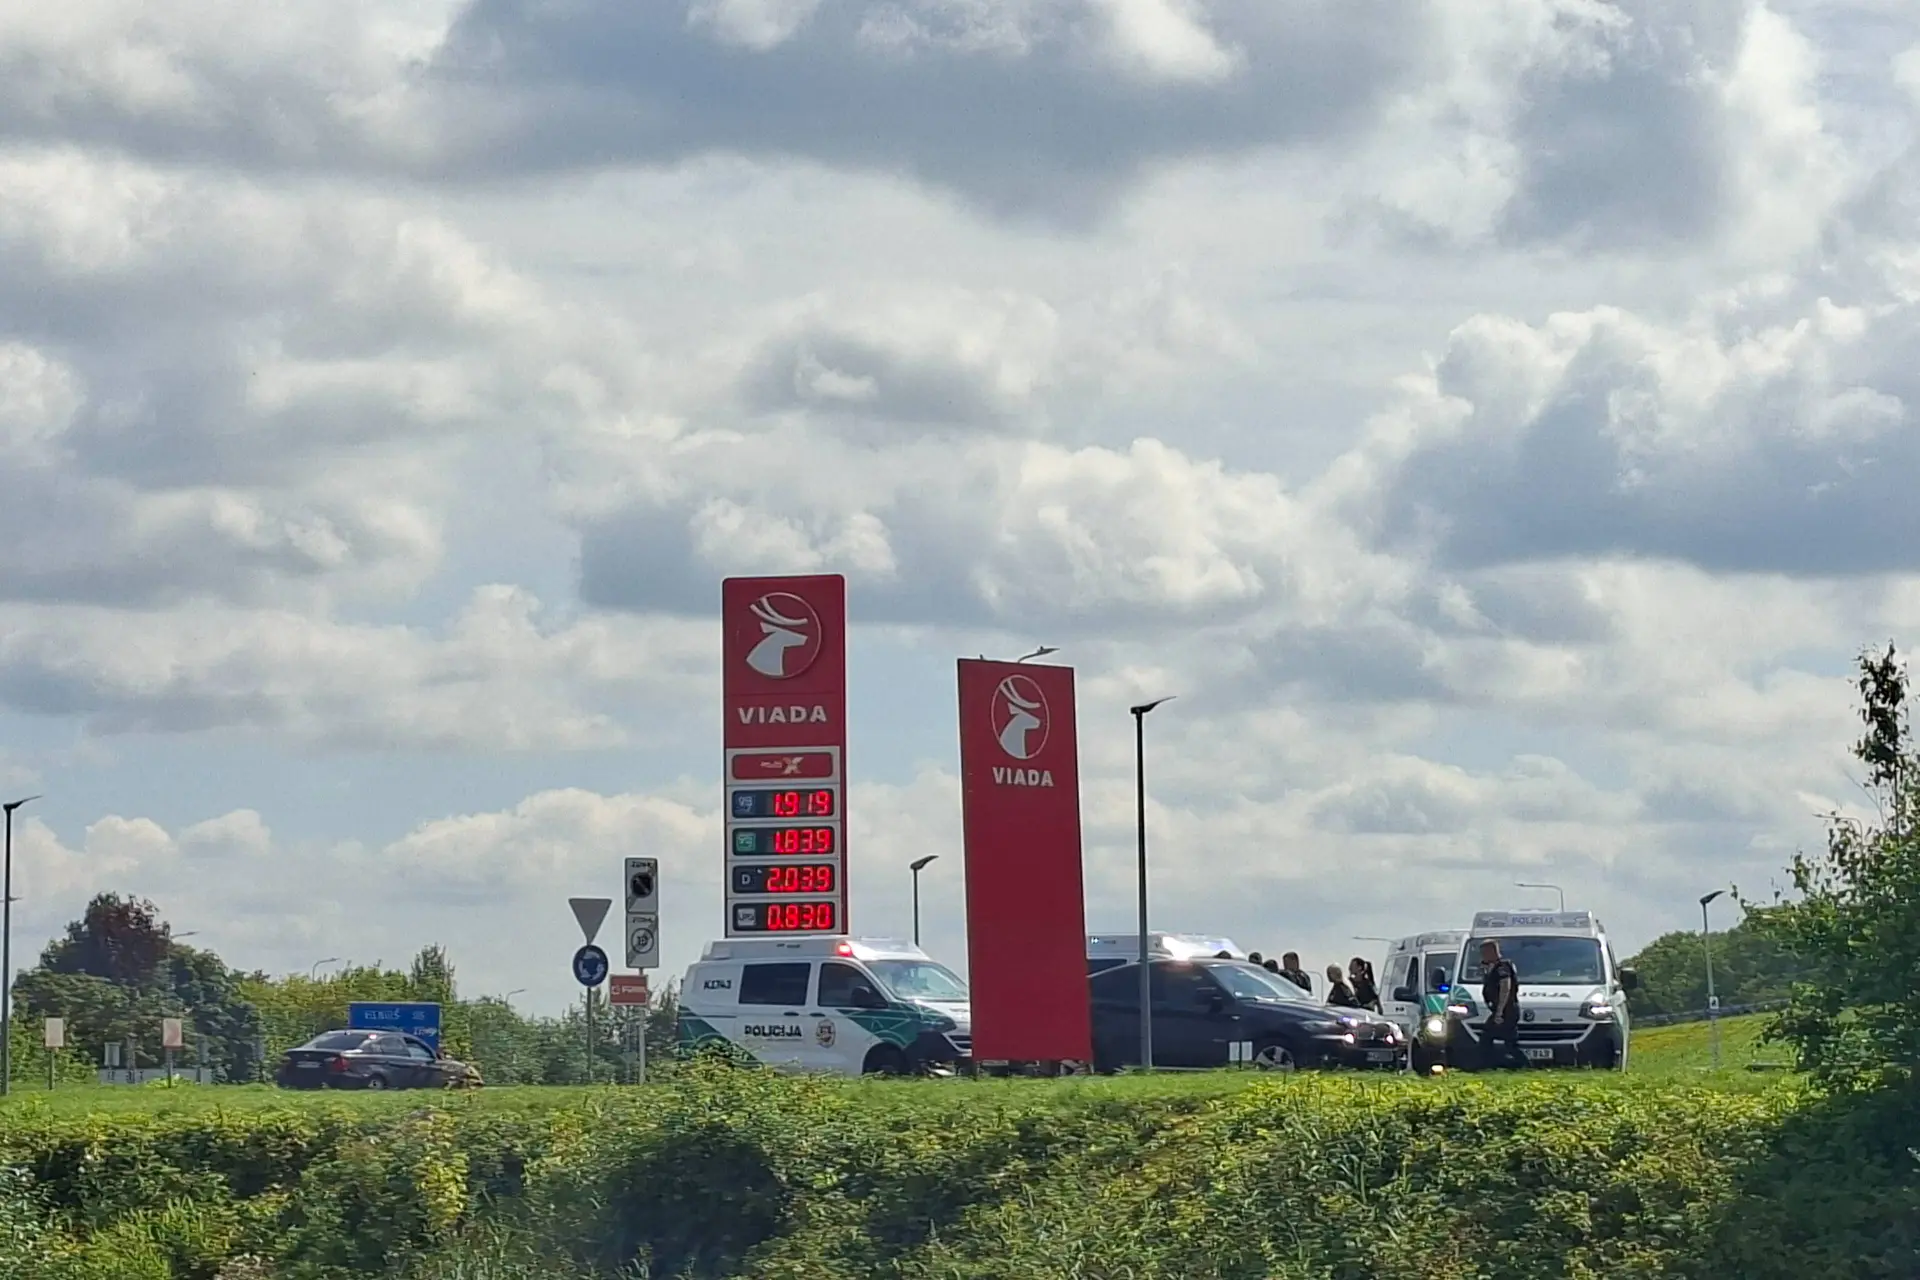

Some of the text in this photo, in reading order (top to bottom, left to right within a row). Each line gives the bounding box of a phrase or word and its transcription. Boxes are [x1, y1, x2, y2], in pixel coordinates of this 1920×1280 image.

[738, 706, 826, 724] VIADA
[992, 767, 1054, 787] VIADA
[775, 791, 832, 816] 1.919
[775, 829, 832, 854] 1.839
[742, 866, 832, 892] D 2.039
[767, 905, 832, 931] 0.830
[1512, 916, 1554, 925] POLICIJA
[744, 1025, 802, 1037] POLICIJA
